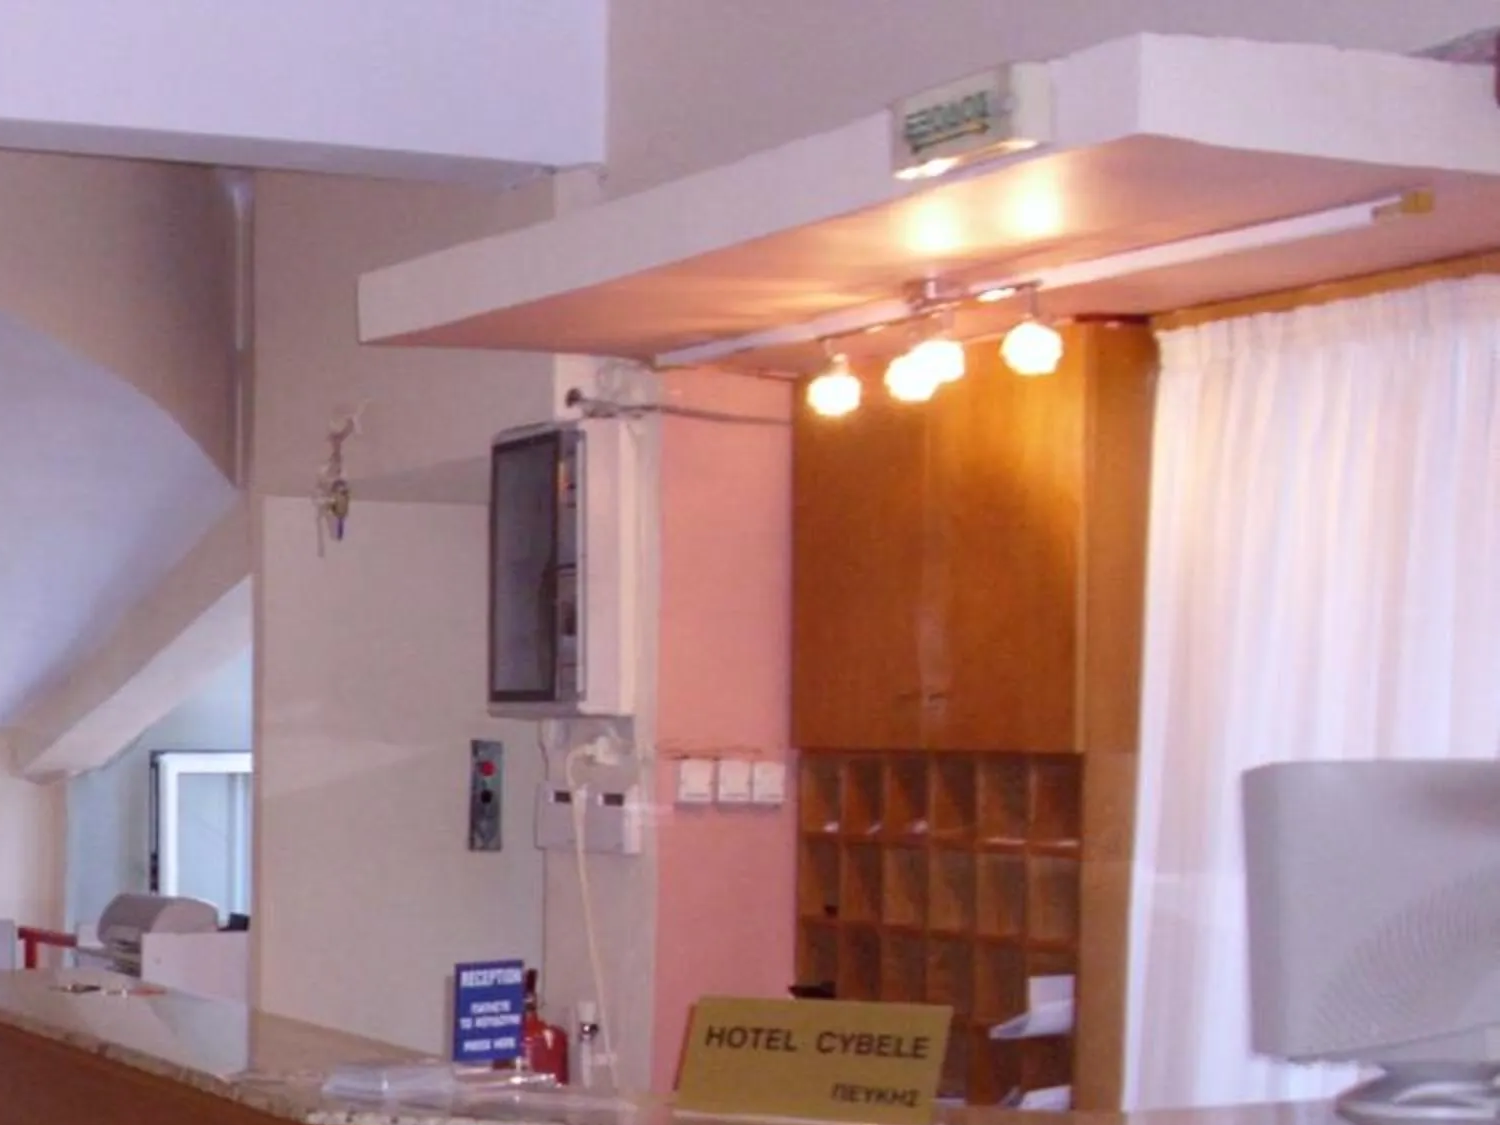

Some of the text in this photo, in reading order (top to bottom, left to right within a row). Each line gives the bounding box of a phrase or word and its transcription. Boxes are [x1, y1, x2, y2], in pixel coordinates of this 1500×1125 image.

[460, 968, 522, 987] RECEPTION
[704, 1026, 931, 1059] HOTEL CYBELE
